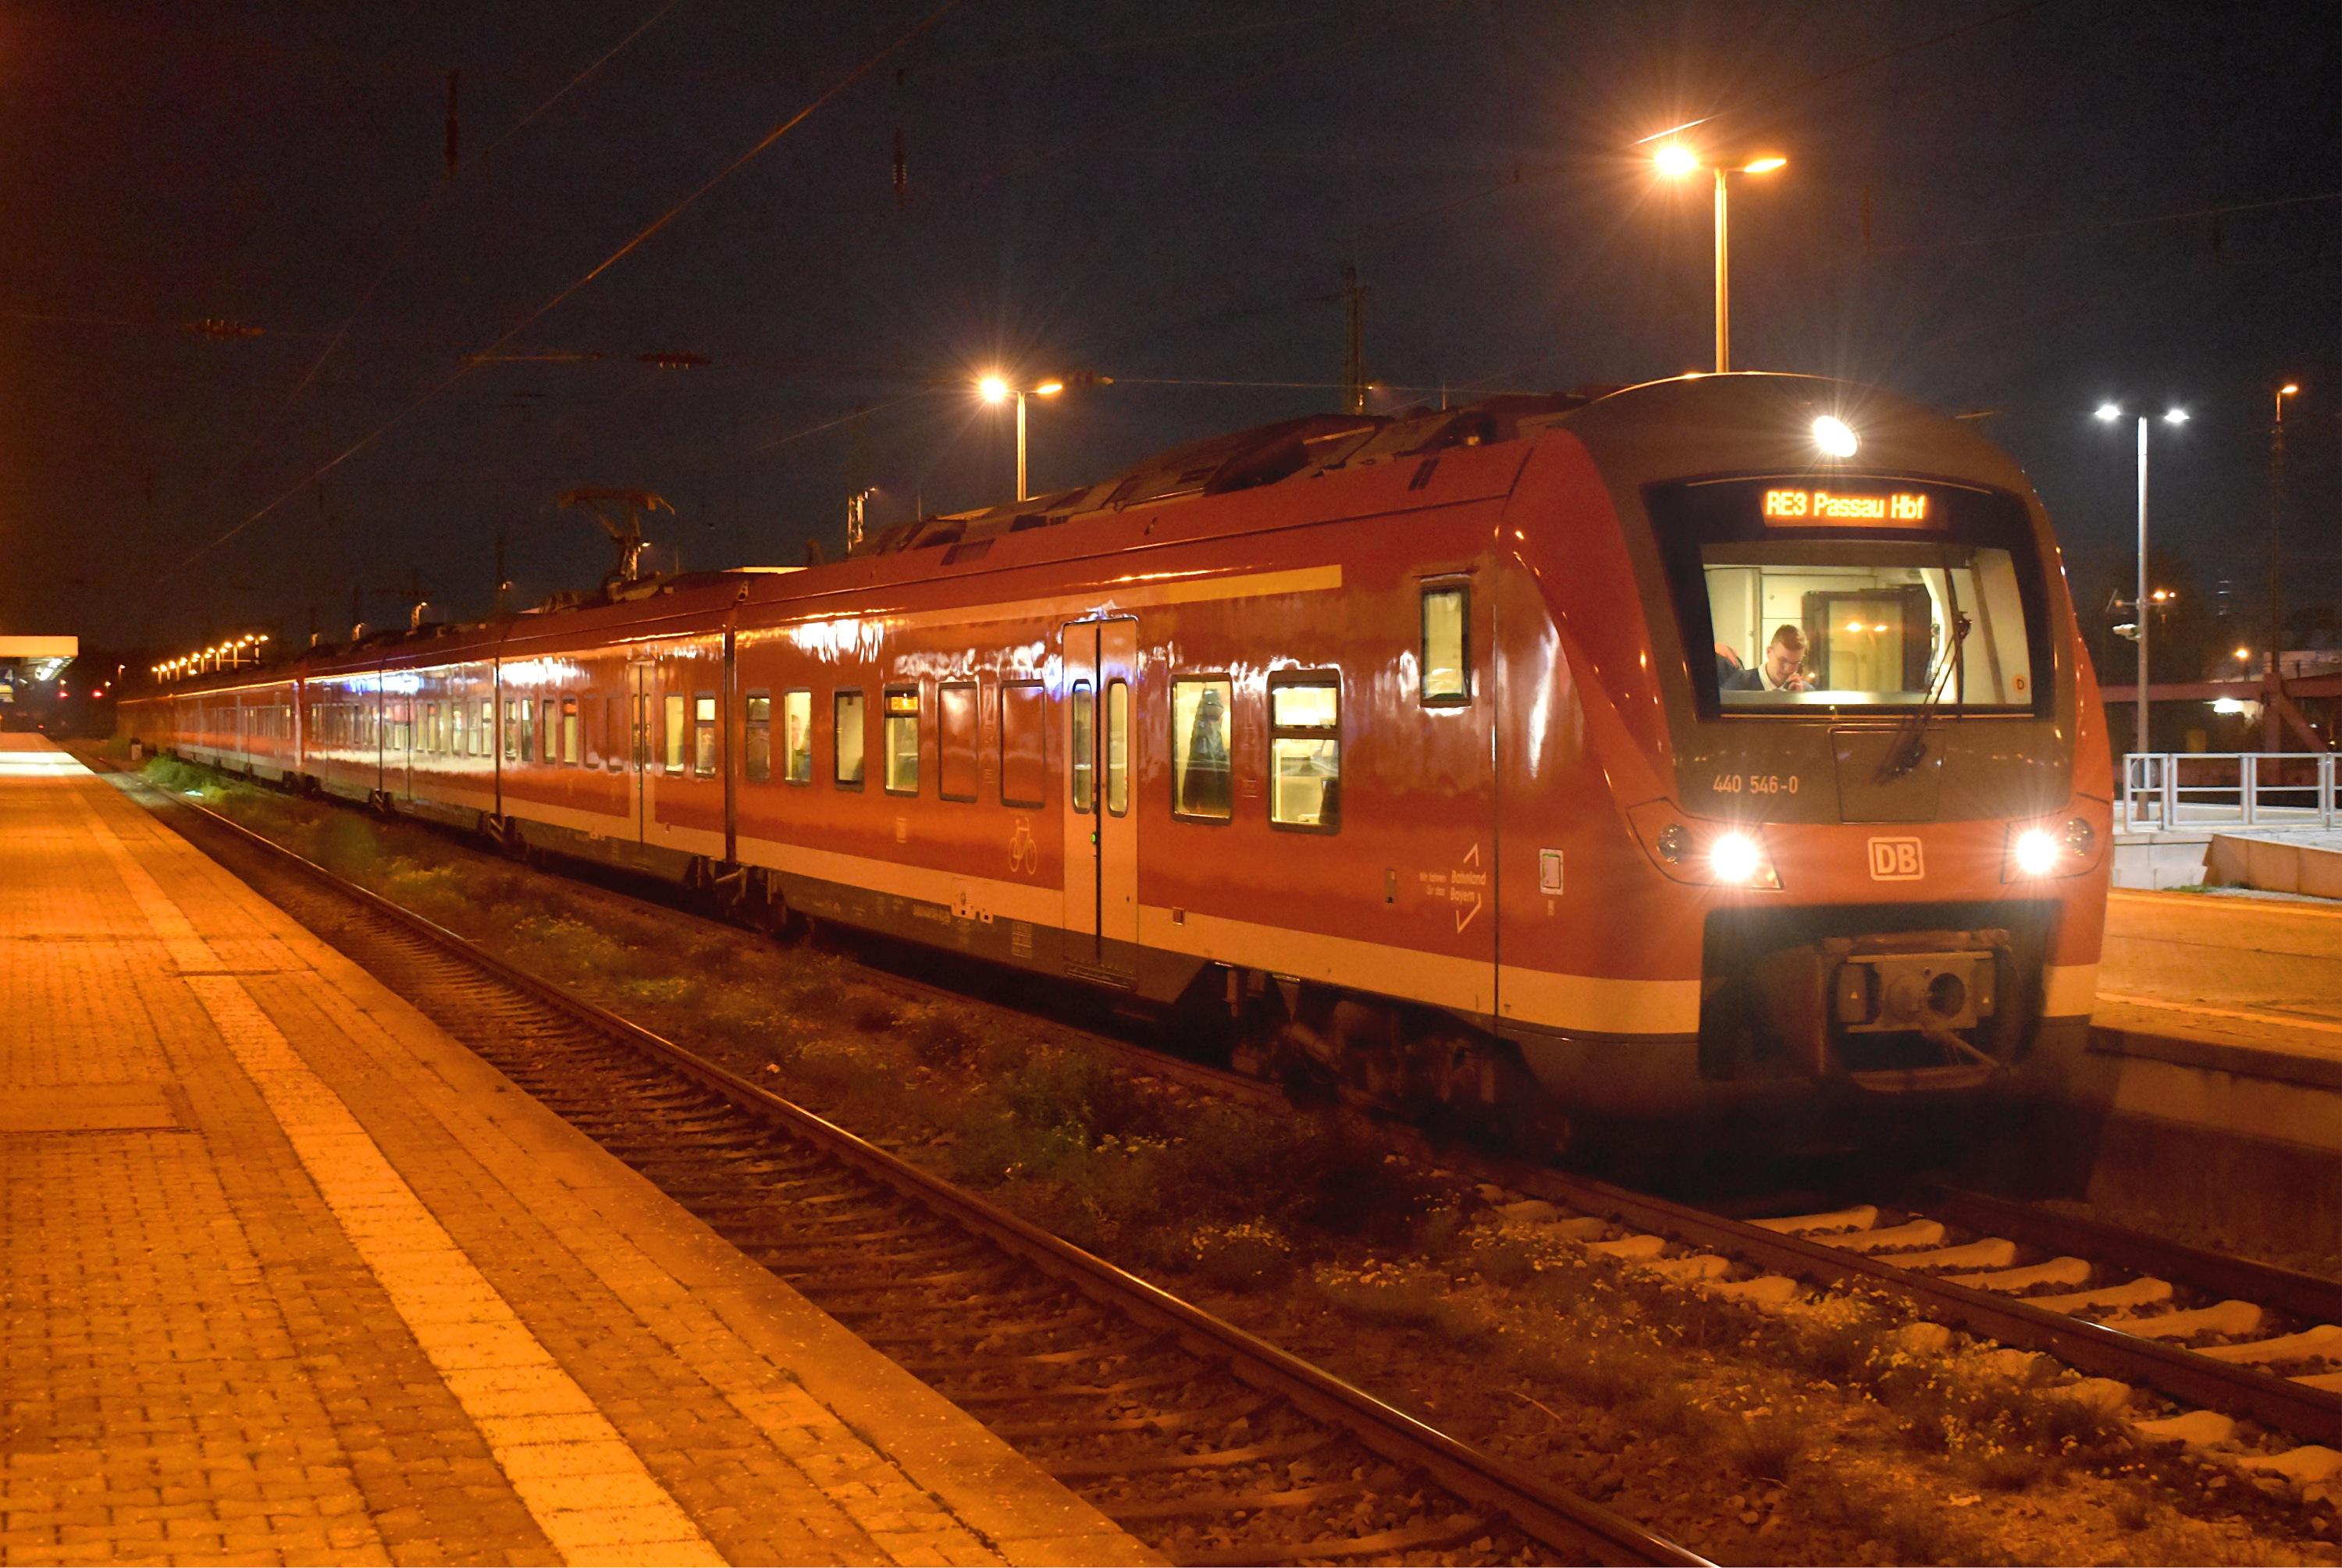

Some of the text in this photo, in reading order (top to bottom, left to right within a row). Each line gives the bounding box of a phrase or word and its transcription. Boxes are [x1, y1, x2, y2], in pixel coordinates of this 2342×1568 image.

[1767, 490, 1926, 519] RE3 Passau Hbf
[1713, 774, 1799, 794] 440 546-0
[1874, 842, 1918, 875] DB
